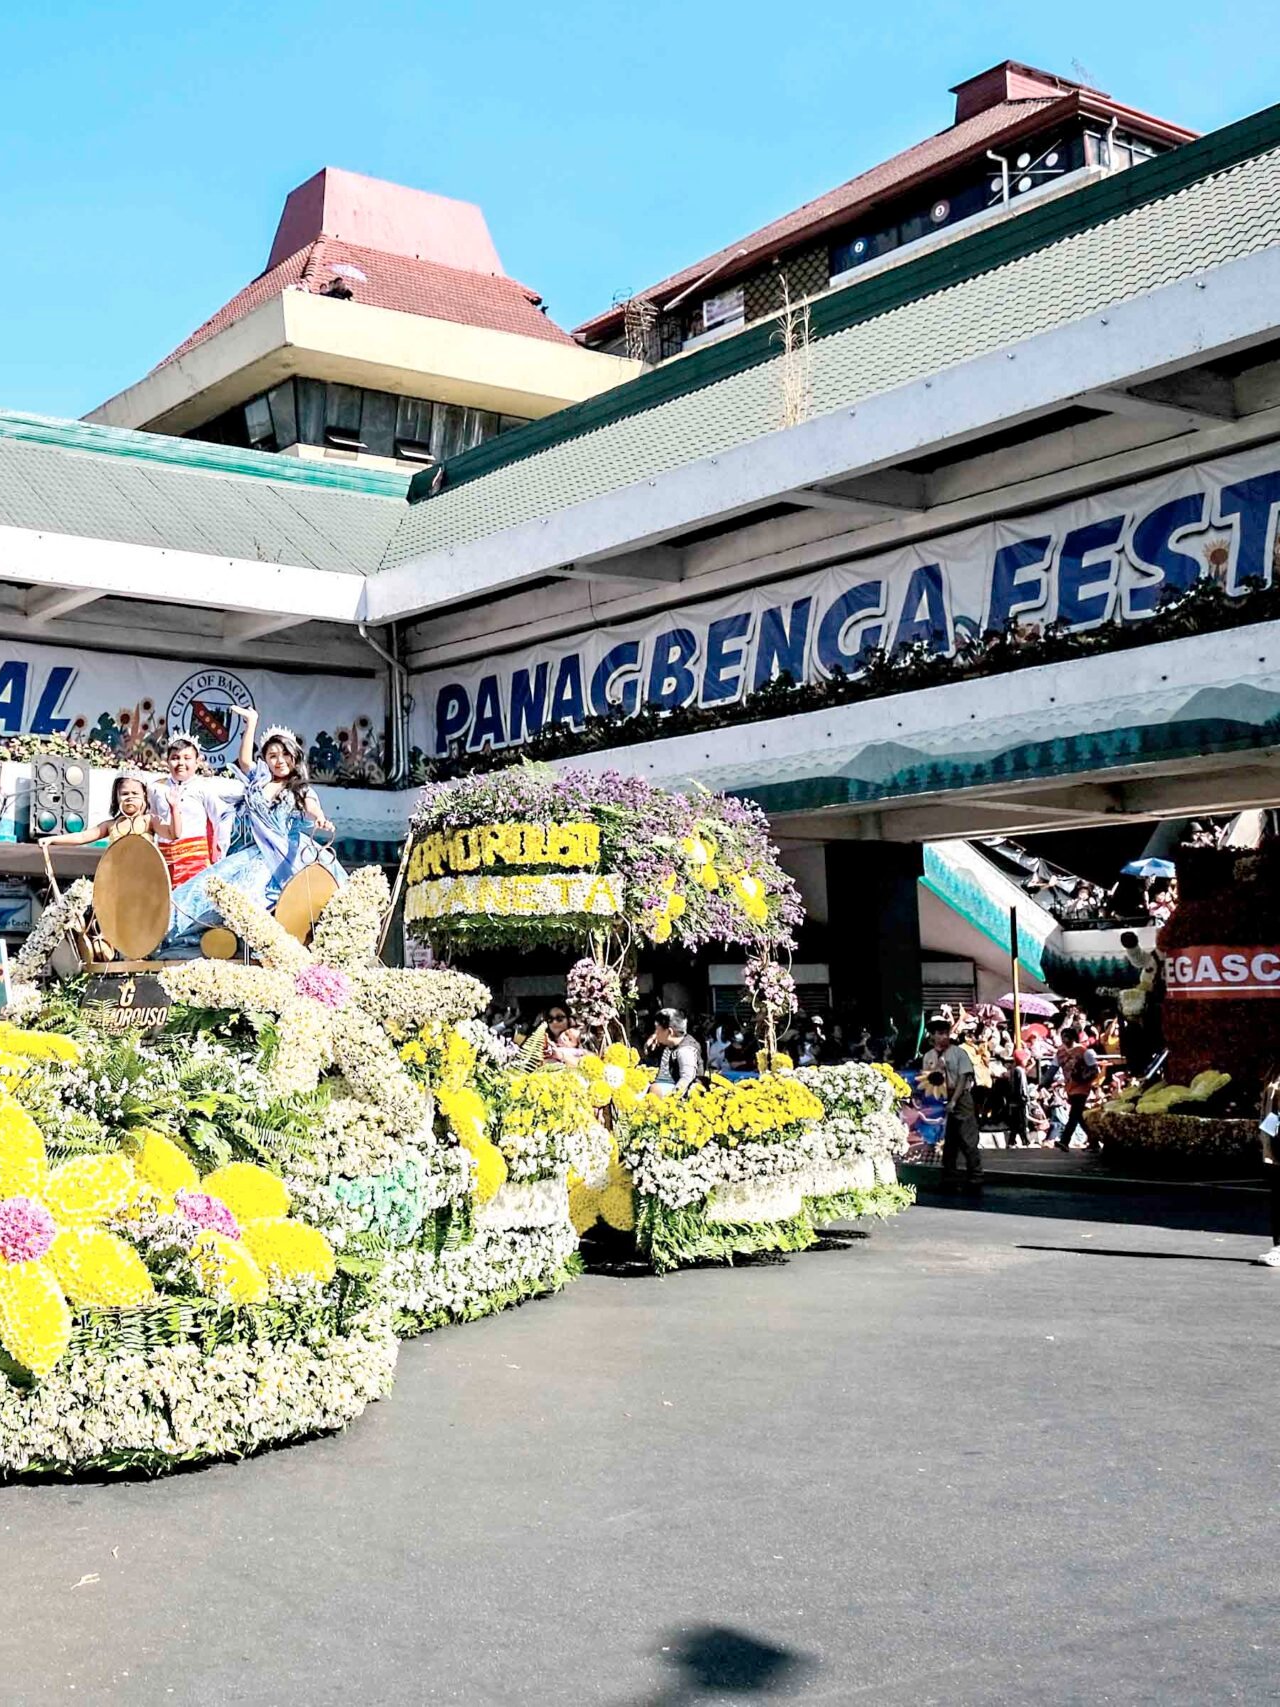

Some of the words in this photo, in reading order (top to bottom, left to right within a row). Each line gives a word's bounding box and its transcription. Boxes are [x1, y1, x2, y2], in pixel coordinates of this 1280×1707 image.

[171, 682, 195, 718] CITY
[197, 674, 215, 688] OF
[217, 675, 250, 711] BAGU
[434, 562, 954, 757] PANAGBENGA
